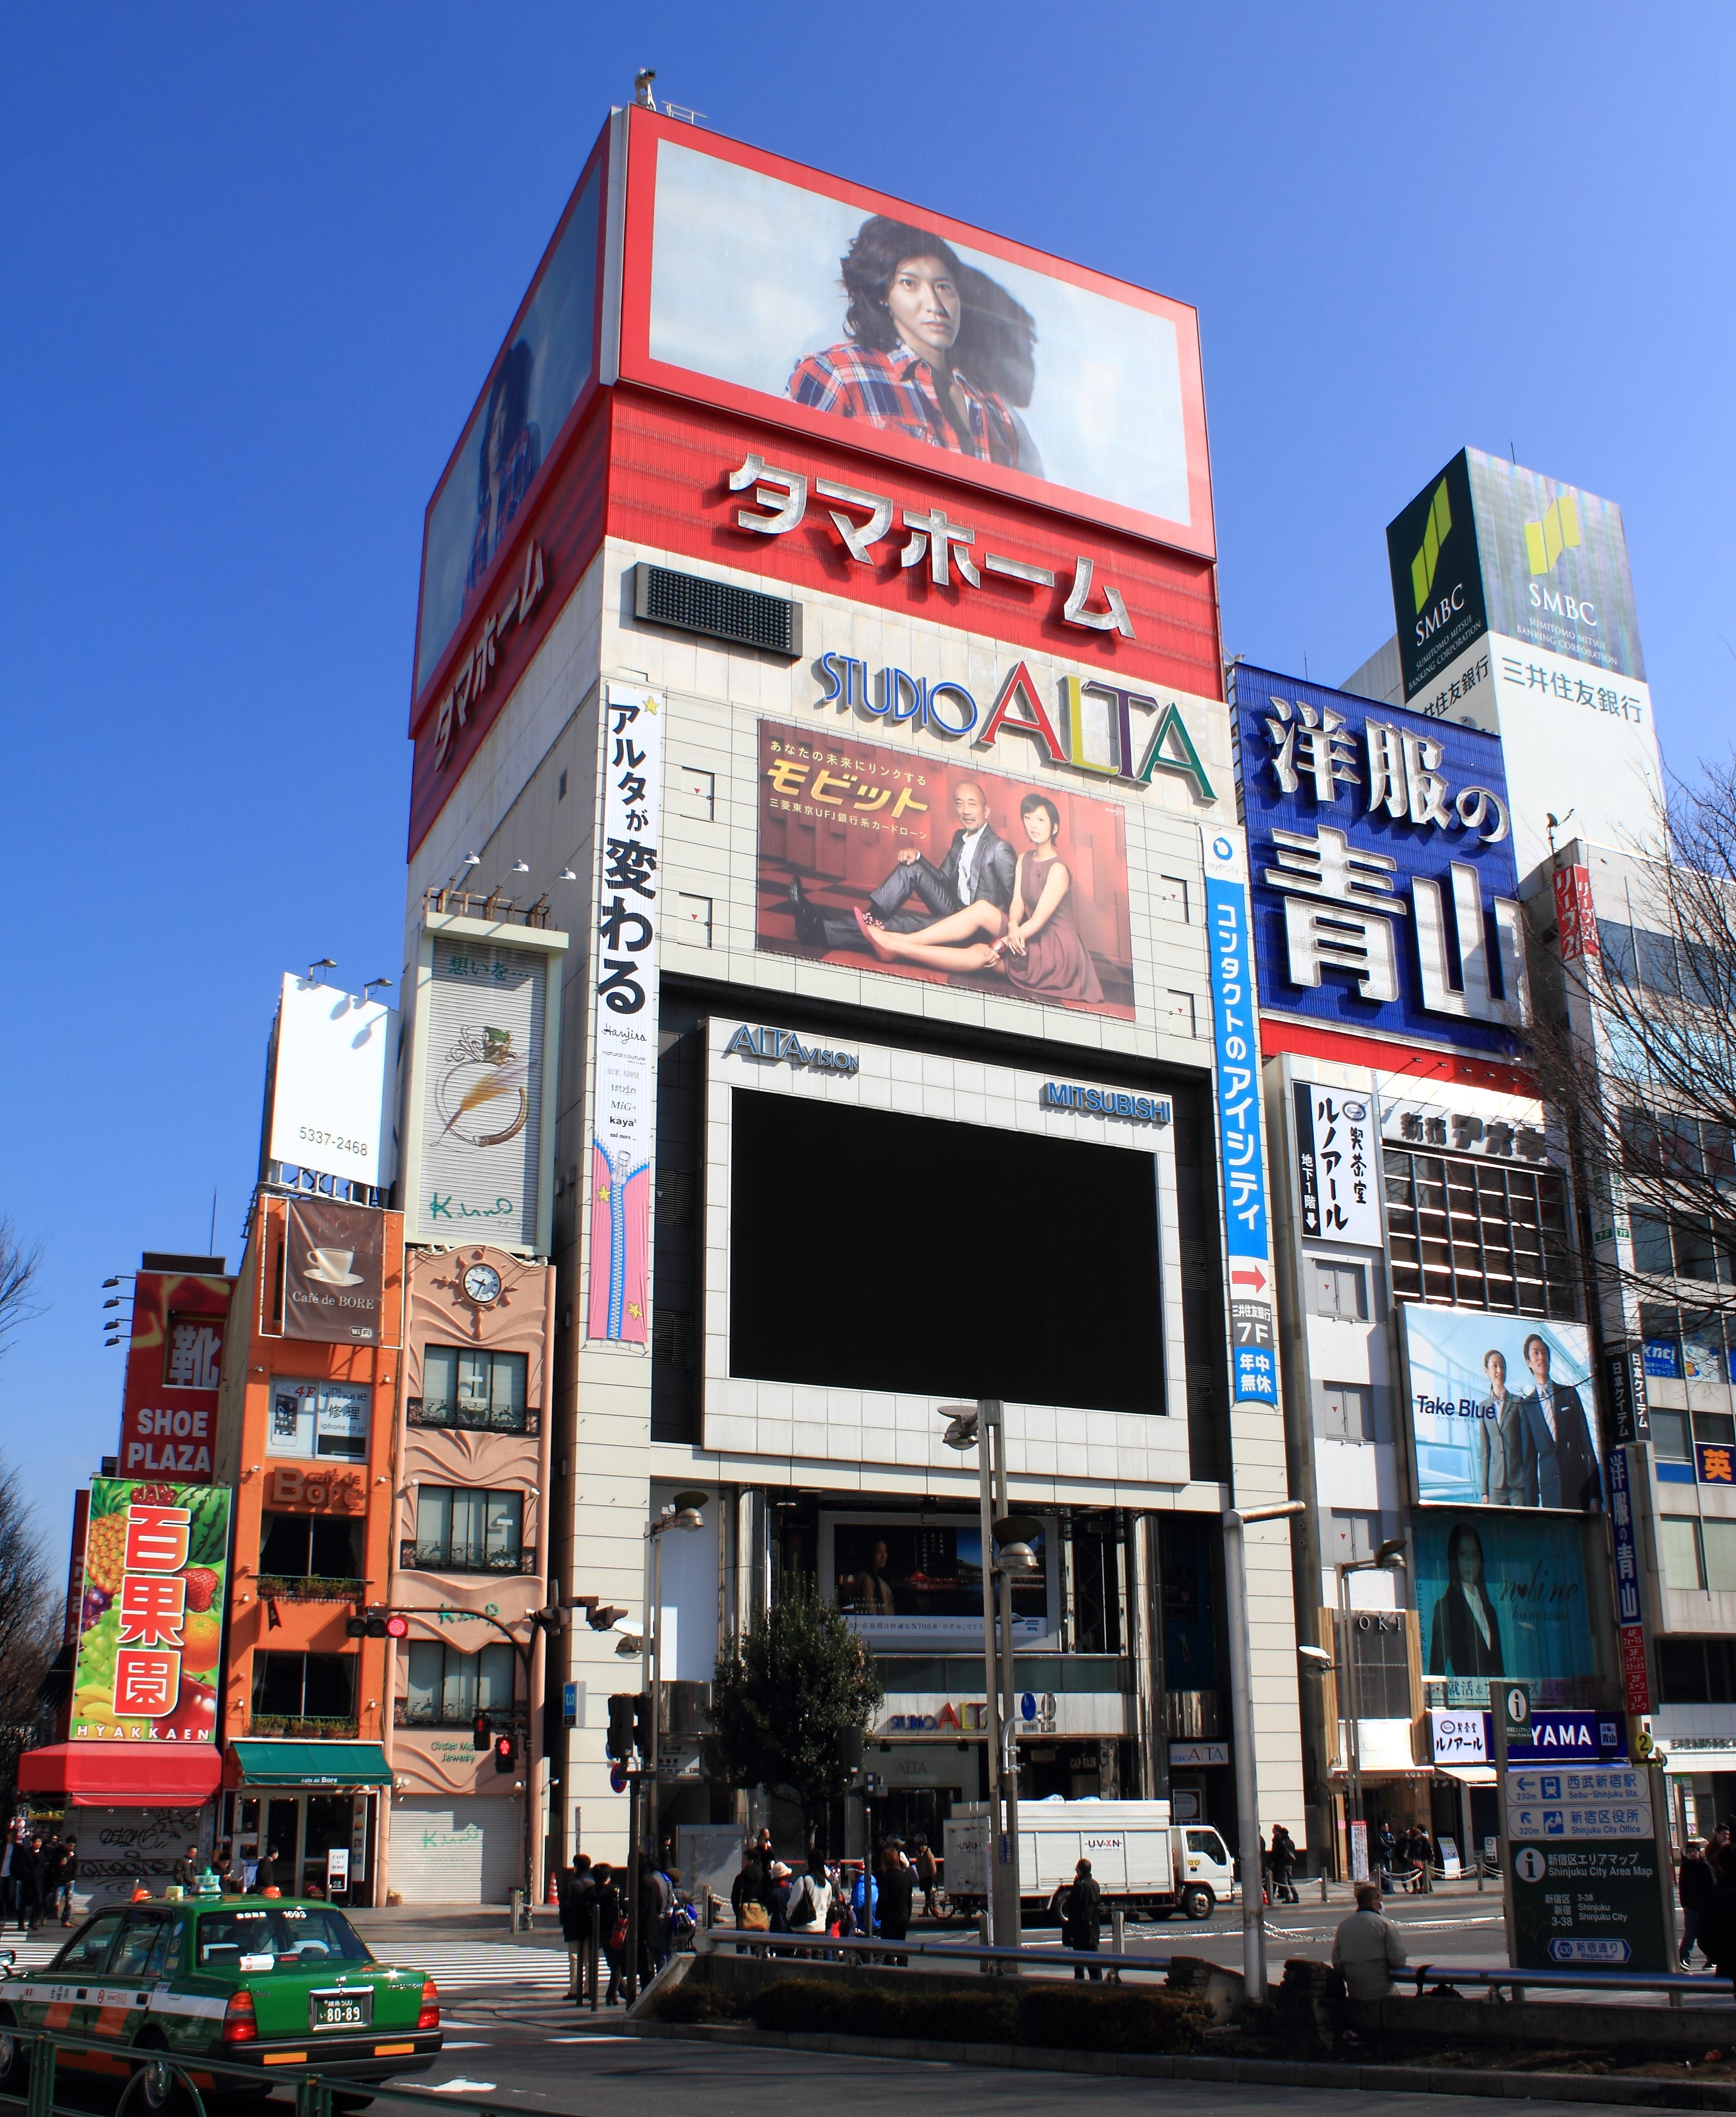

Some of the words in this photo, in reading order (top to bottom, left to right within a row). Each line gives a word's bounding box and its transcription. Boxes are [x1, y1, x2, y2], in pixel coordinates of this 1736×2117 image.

[729, 453, 1136, 638] タマホーム
[1416, 583, 1465, 647] SMBC
[1529, 583, 1597, 627] SMBC
[1416, 636, 1449, 670] SUMITOMO
[1450, 615, 1472, 639] MITSUI
[1517, 625, 1556, 645] BANKING
[1559, 640, 1618, 666] CORPORATION
[1529, 617, 1576, 640] SUMITOMO
[1578, 633, 1606, 651] MITSUI
[1409, 659, 1436, 691] BANKING
[1436, 621, 1481, 663] CORPORATION
[1501, 656, 1643, 724] 三井住友銀行
[822, 652, 978, 736] STUDIO
[979, 661, 1218, 802] ALTA
[771, 741, 927, 786] あなたの未来にリンクする
[1265, 697, 1510, 843] 洋服の
[767, 759, 928, 818] モビット
[769, 798, 928, 840] 三菱東京UFJ銀行系カードローン
[599, 703, 658, 1014] アルタが変わる
[1208, 862, 1239, 875] eyecity
[1264, 825, 1531, 1028] 青山
[1218, 904, 1260, 1230] コンタクトのアイシティ
[1046, 1081, 1171, 1123] MITSUBISHI
[299, 1126, 368, 1157] 5337-2468
[1317, 1097, 1349, 1232] ルノアール
[1349, 1126, 1367, 1205] 喫茶室
[1301, 1153, 1316, 1209] 地下1階
[292, 1291, 319, 1304] Café
[322, 1295, 335, 1306] de
[339, 1296, 375, 1309] BORE
[1232, 1304, 1271, 1321] 三井住友銀行
[1236, 1322, 1270, 1343] 7F
[169, 1324, 223, 1388] 靴
[1239, 1353, 1270, 1372] 年中
[294, 1386, 316, 1398] 4F
[329, 1387, 367, 1401] iPhone
[1241, 1374, 1272, 1393] 無休
[1631, 1353, 1649, 1429] 日本ケイテム
[327, 1404, 360, 1420] 修理
[1417, 1395, 1455, 1416] Take
[1459, 1399, 1496, 1420] Blue
[1612, 1361, 1628, 1437] 日本ケイテム
[137, 1408, 208, 1438] SHOE
[127, 1442, 211, 1472] PLAZA
[1703, 1449, 1732, 1481] 英
[1609, 1455, 1638, 1619] 洋服の青山
[113, 1504, 191, 1717] 百果園
[891, 1715, 937, 1730] STUDIO
[937, 1702, 988, 1730] ALT
[1631, 1702, 1647, 1711] スーツ
[77, 1725, 209, 1740] HYAKKAEN
[1435, 1736, 1483, 1752] ルノアール
[1639, 1735, 1648, 1751] 2
[895, 1762, 928, 1774] ALTA
[1189, 1747, 1224, 1761] ALTA
[1567, 1774, 1637, 1789] 西武新宿駅
[1569, 1791, 1623, 1799] Seibu-Shinjuku
[1570, 1809, 1639, 1825] 新宿区役所
[1571, 1825, 1601, 1834] Shinjuku
[1603, 1826, 1617, 1834] City
[1619, 1825, 1641, 1833] Office
[1547, 1852, 1639, 1866] 新宿区エリアマップ
[1548, 1866, 1587, 1877] Shinjuku
[1590, 1866, 1607, 1878] City
[1610, 1866, 1631, 1876] Area
[1633, 1866, 1653, 1877] Map
[1545, 1894, 1571, 1904] 新宿区
[1554, 1906, 1571, 1915] 新宿
[1578, 1903, 1610, 1912] Shinjuku
[1551, 1917, 1573, 1927] 3-38
[1579, 1913, 1611, 1922] Shinjuku
[1612, 1913, 1627, 1922] City
[1577, 1942, 1618, 1952] 新宿通り
[327, 2006, 360, 2022] 80-89
